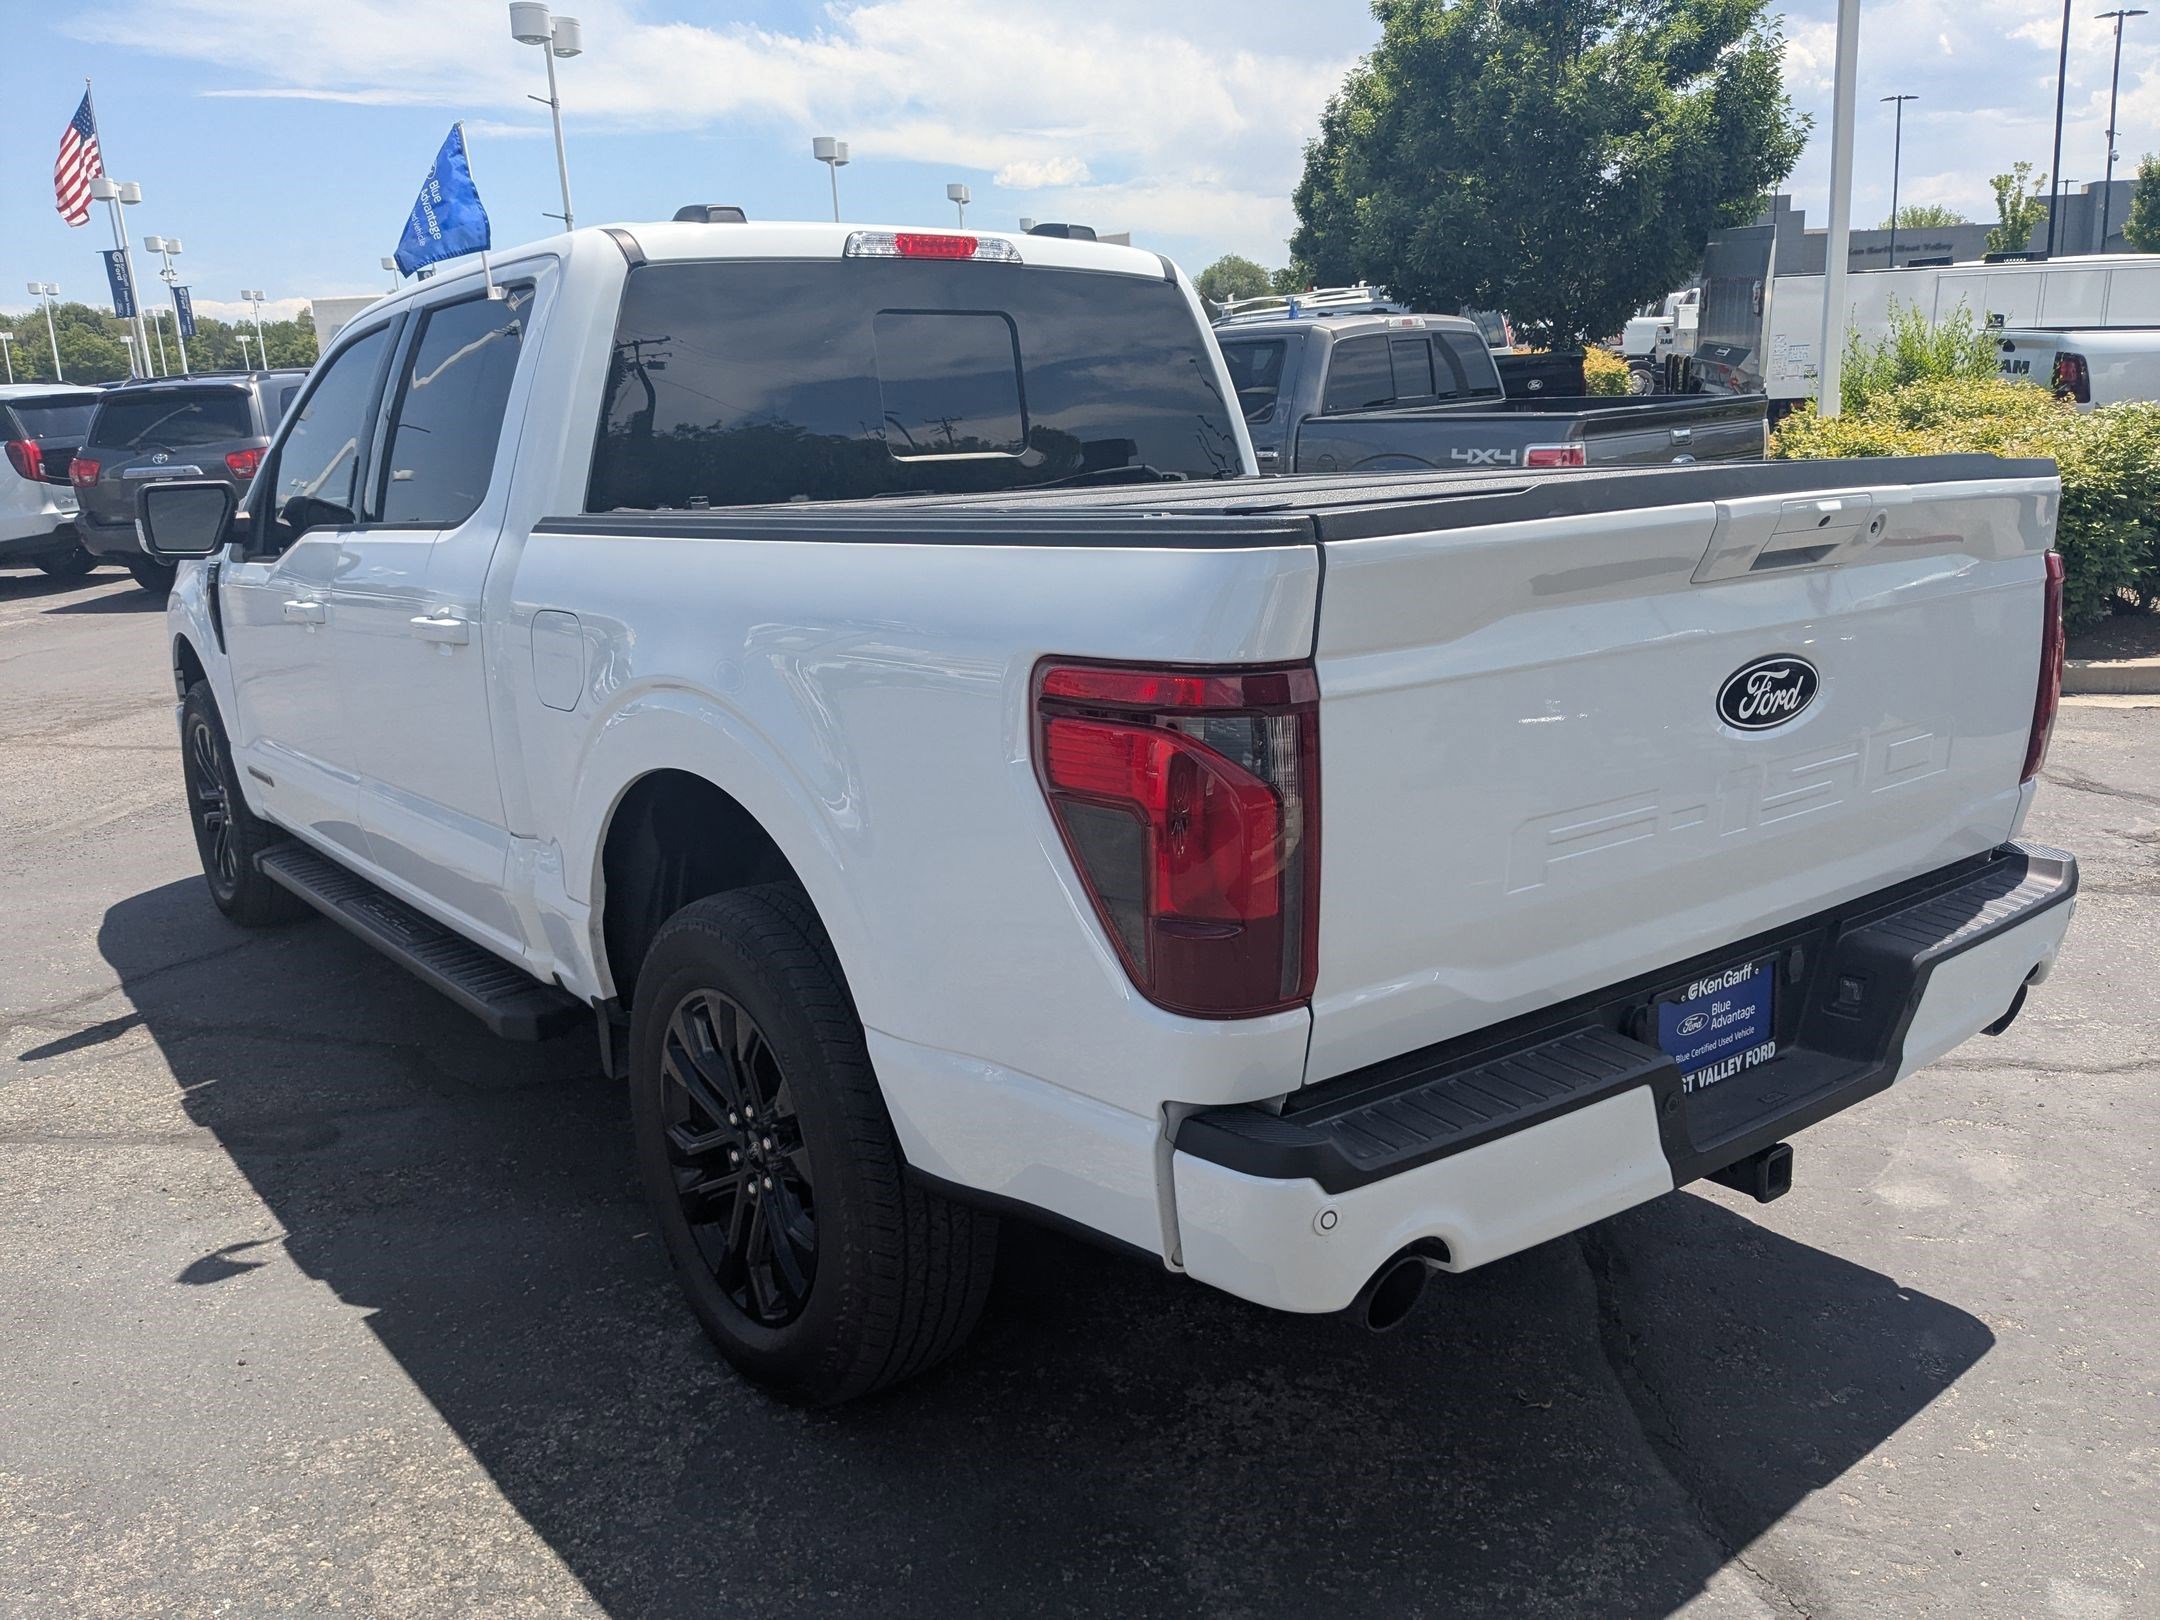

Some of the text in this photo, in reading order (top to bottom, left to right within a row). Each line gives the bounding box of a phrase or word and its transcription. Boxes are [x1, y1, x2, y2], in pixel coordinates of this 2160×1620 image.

[429, 180, 442, 203] Blue
[114, 263, 124, 281] Ford
[1739, 668, 1804, 720] Ford
[1698, 962, 1753, 998] Ken Garff
[1710, 1004, 1756, 1032] Advantage
[1711, 999, 1731, 1017] Blue
[1682, 1015, 1703, 1035] Ford
[1675, 1025, 1755, 1064] Blue Certified Used Vehicle
[1698, 1054, 1743, 1089] VALLEY
[1745, 1041, 1776, 1070] FORD
